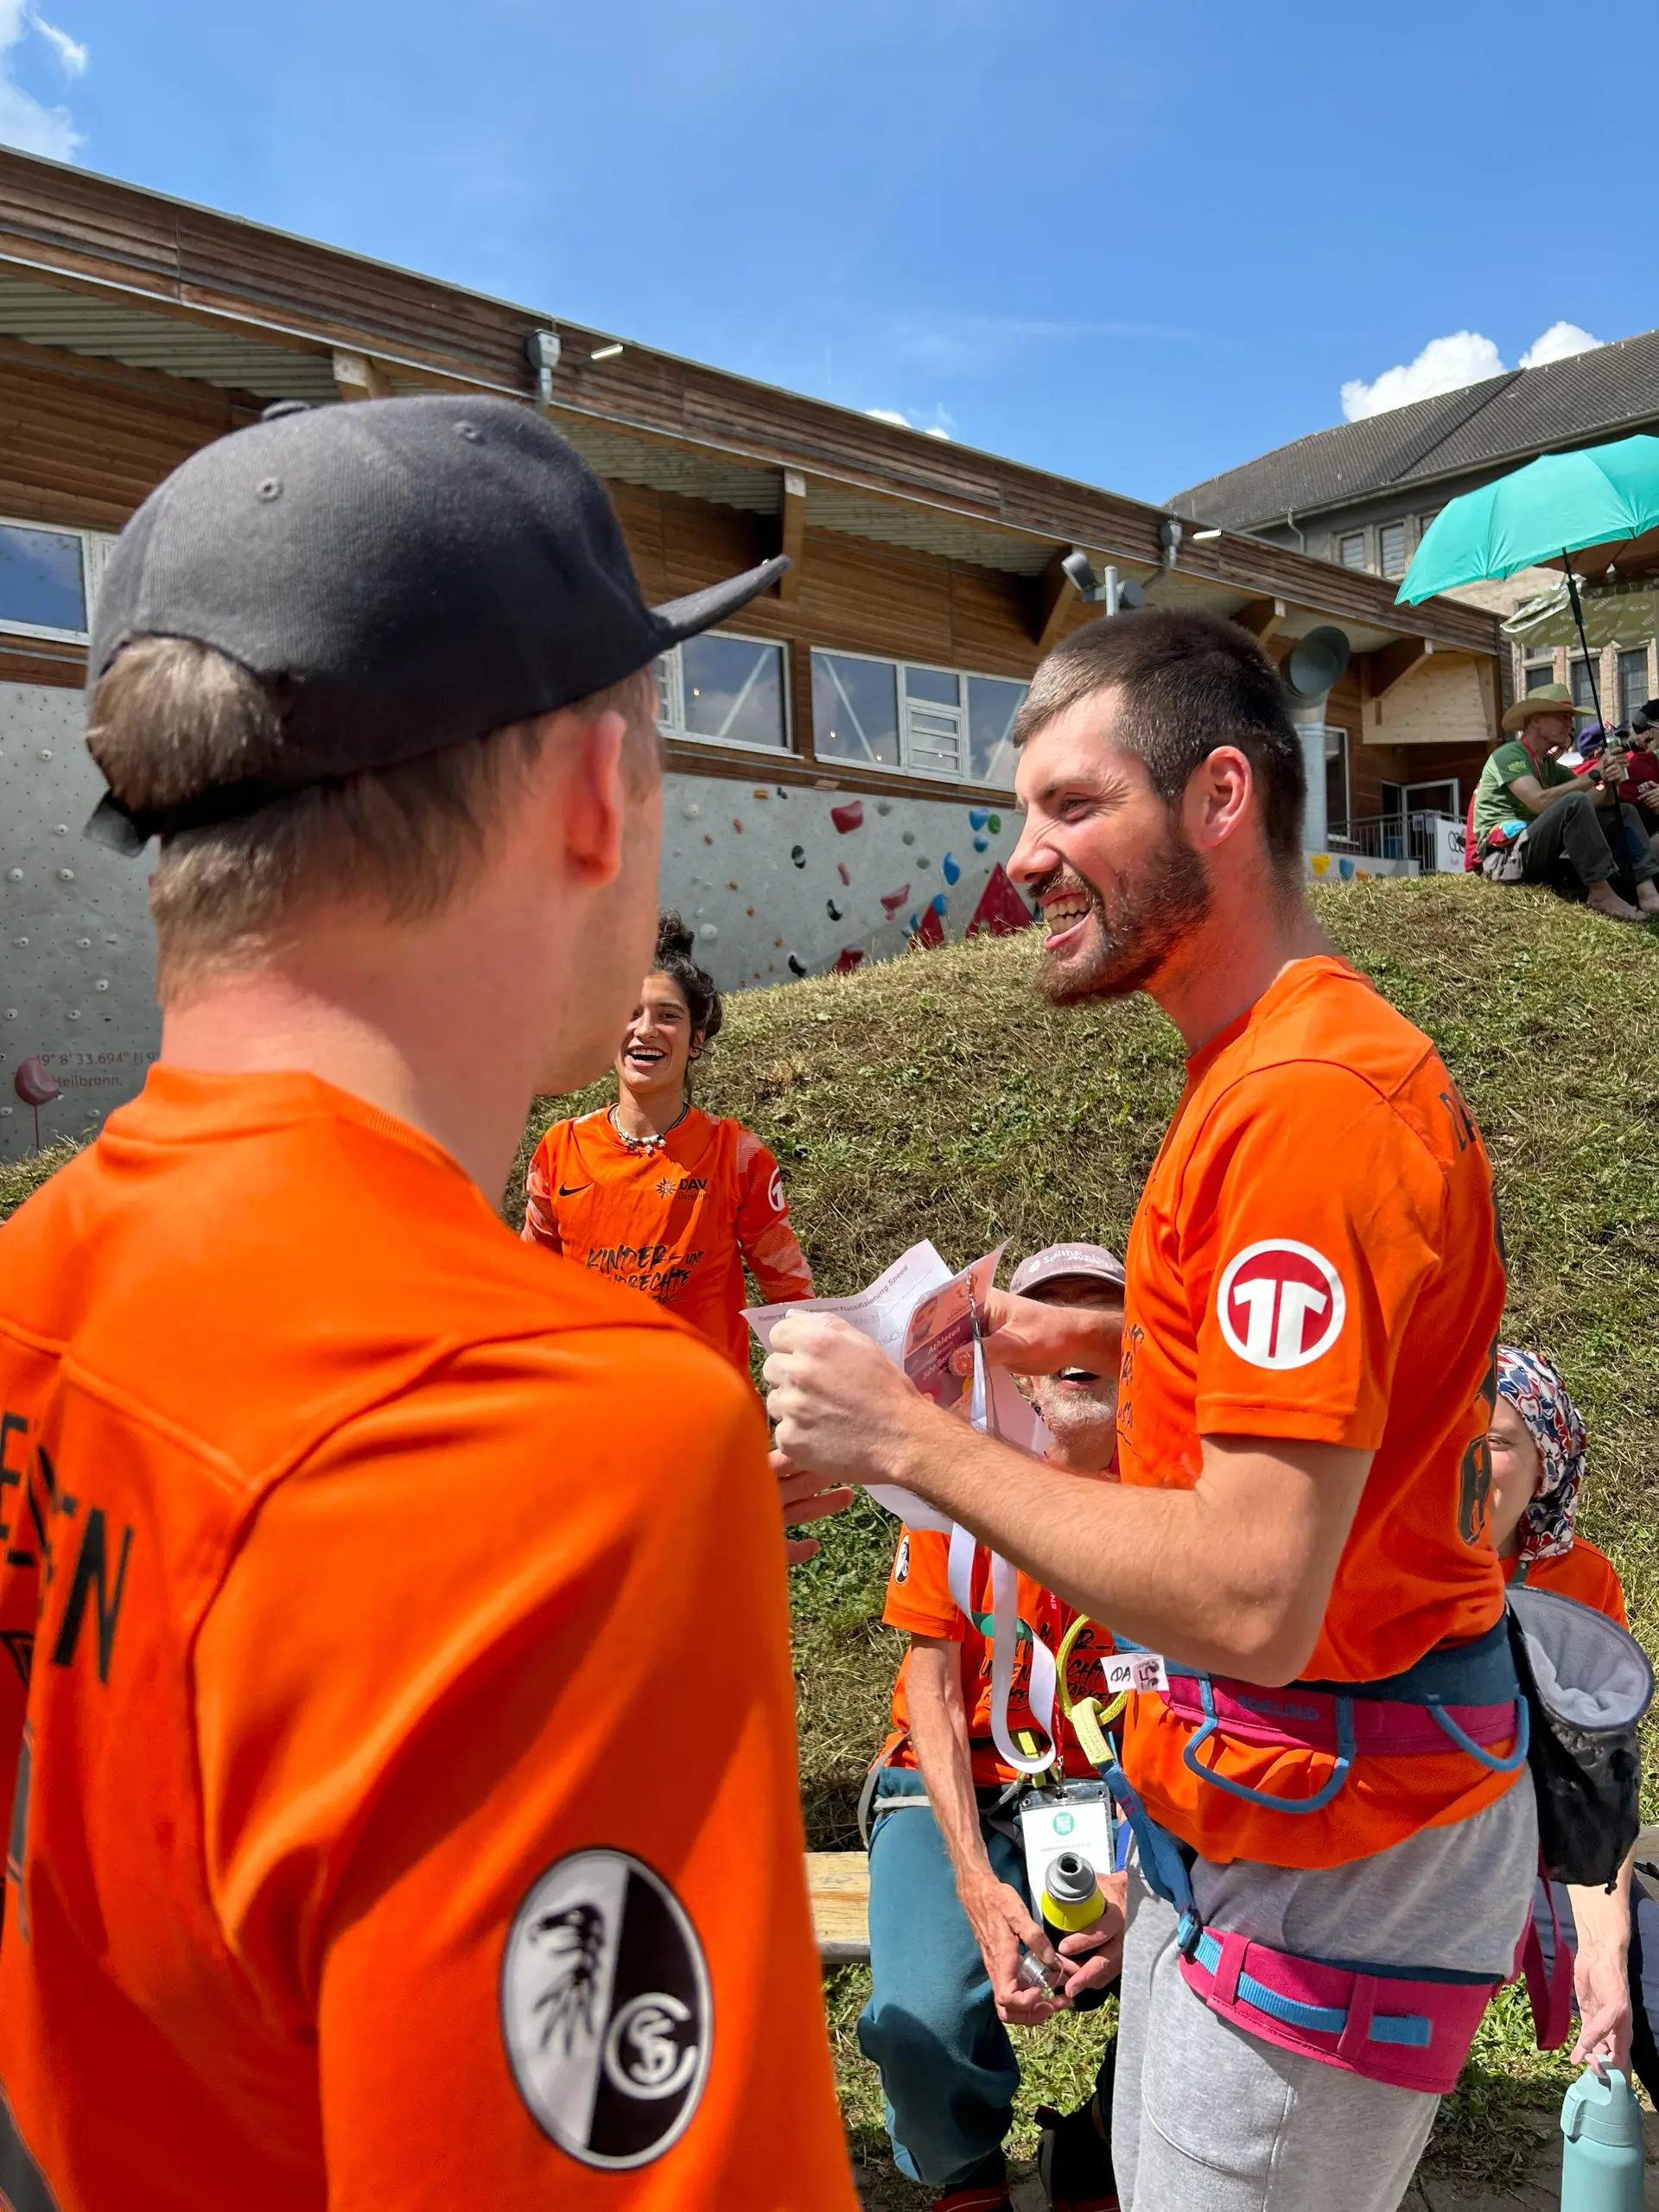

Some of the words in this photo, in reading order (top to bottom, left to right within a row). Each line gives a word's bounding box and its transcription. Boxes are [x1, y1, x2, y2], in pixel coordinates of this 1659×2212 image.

[679, 1178, 708, 1190] DAV
[840, 1285, 889, 1312] Klassifizierung
[887, 1264, 908, 1287] Speed
[927, 1325, 961, 1356] Athleten
[923, 1363, 938, 1380] John
